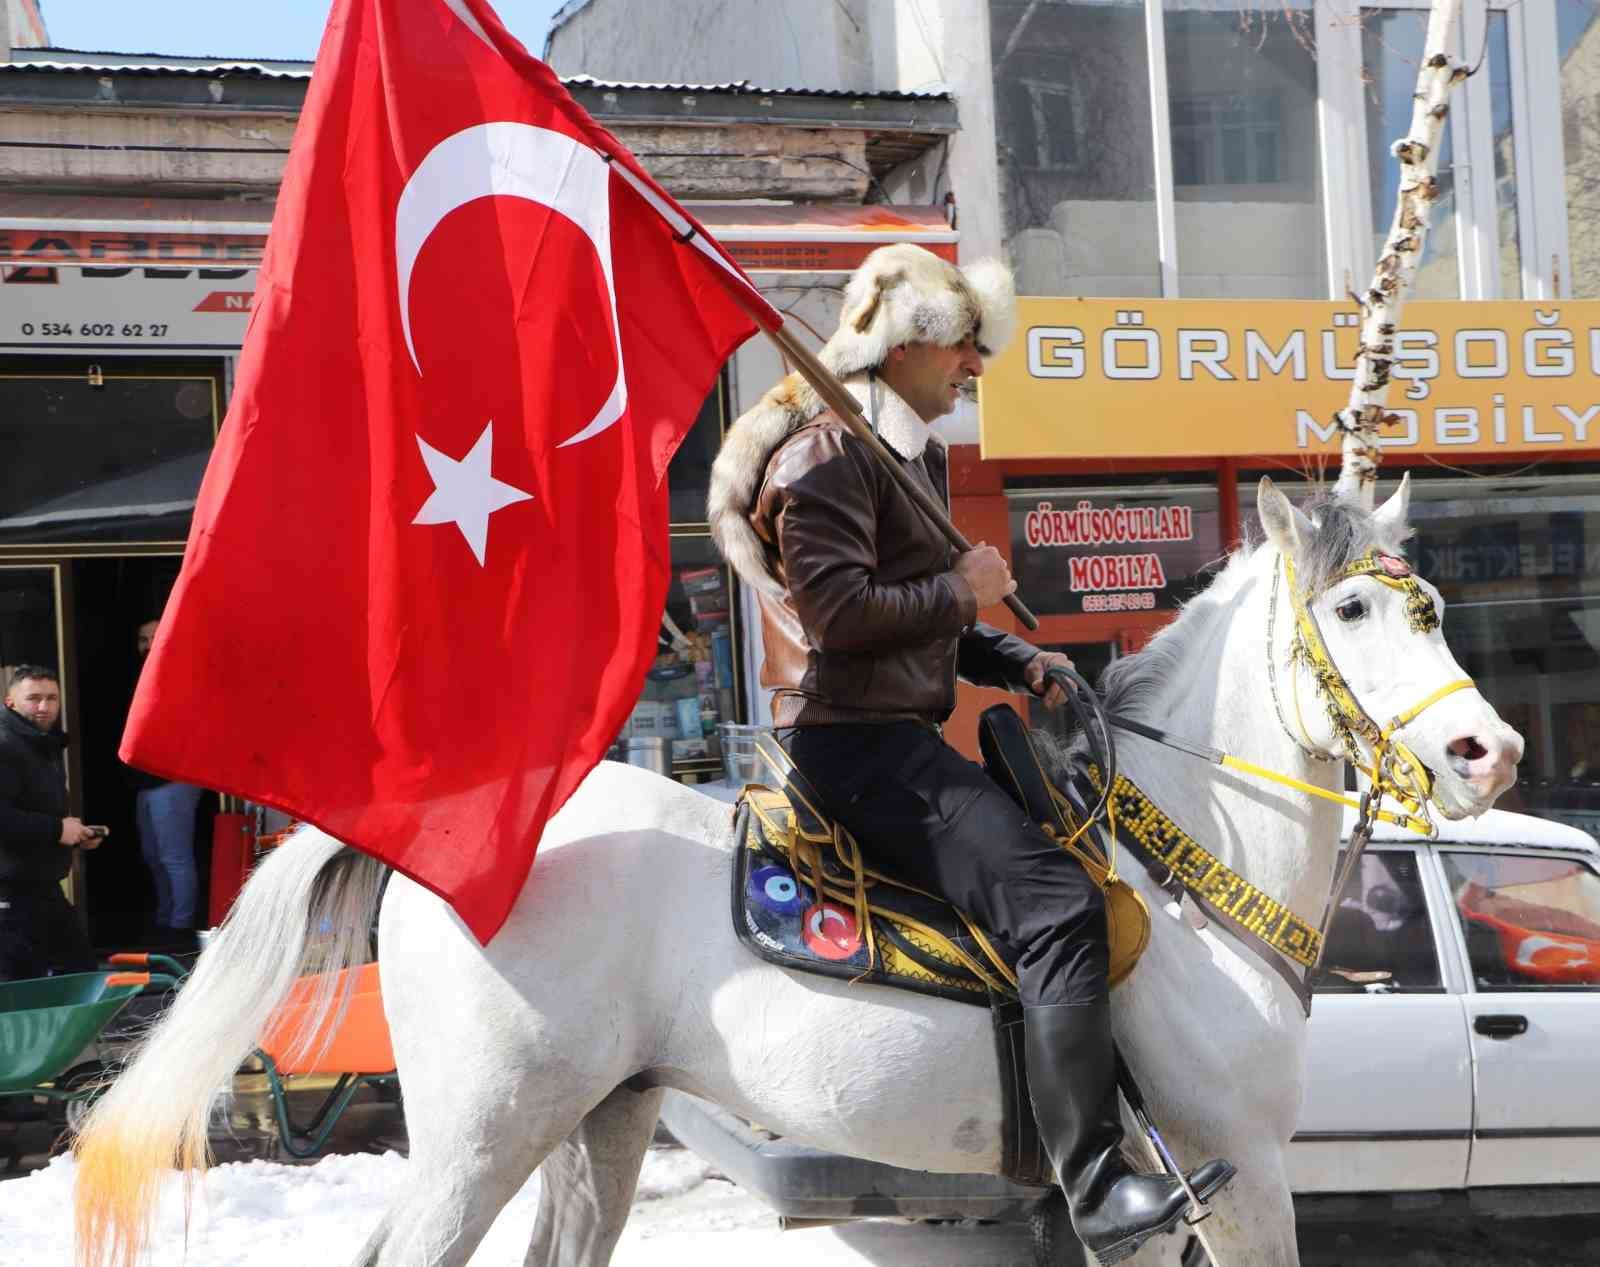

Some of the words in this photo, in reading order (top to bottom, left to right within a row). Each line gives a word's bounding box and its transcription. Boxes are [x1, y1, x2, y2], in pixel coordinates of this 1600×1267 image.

[41, 322, 73, 336] 534
[79, 322, 115, 337] 602
[121, 323, 143, 337] 62
[149, 323, 168, 337] 27
[1026, 308, 1600, 401] GÖRMÜŞOĞ
